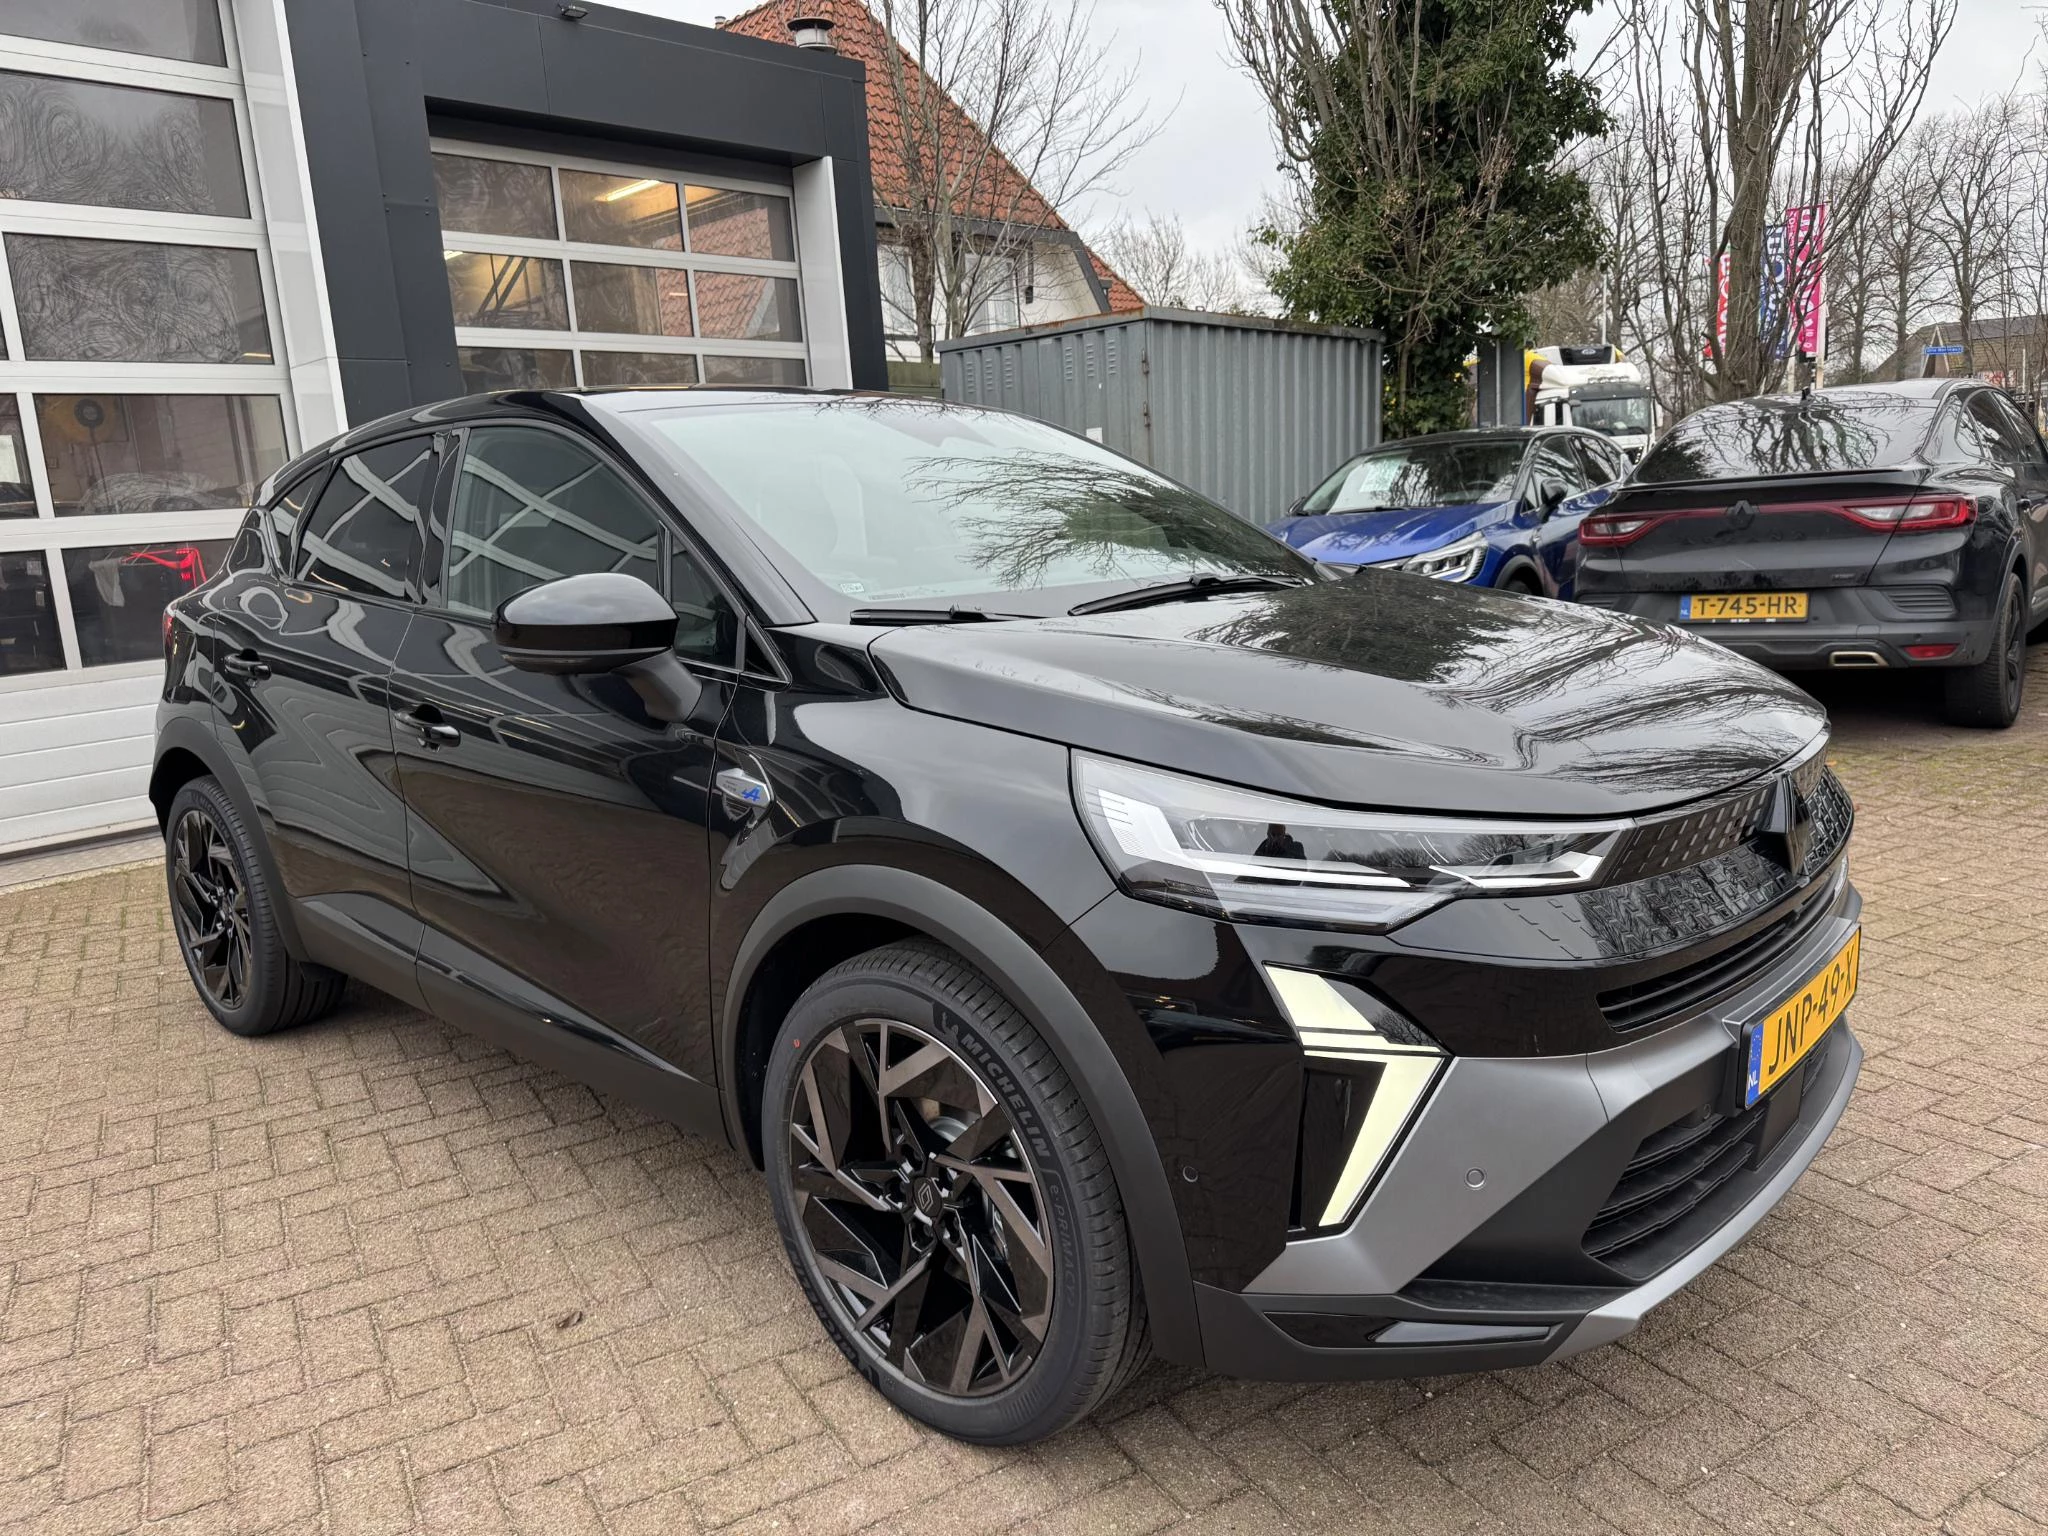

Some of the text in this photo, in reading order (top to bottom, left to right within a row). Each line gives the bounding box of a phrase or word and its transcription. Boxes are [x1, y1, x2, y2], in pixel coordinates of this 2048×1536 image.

[1697, 596, 1797, 615] T-745-HR
[1768, 943, 1855, 1076] JNP-49-X
[961, 1033, 1050, 1157] MICHELIN
[1747, 1069, 1758, 1090] NL
